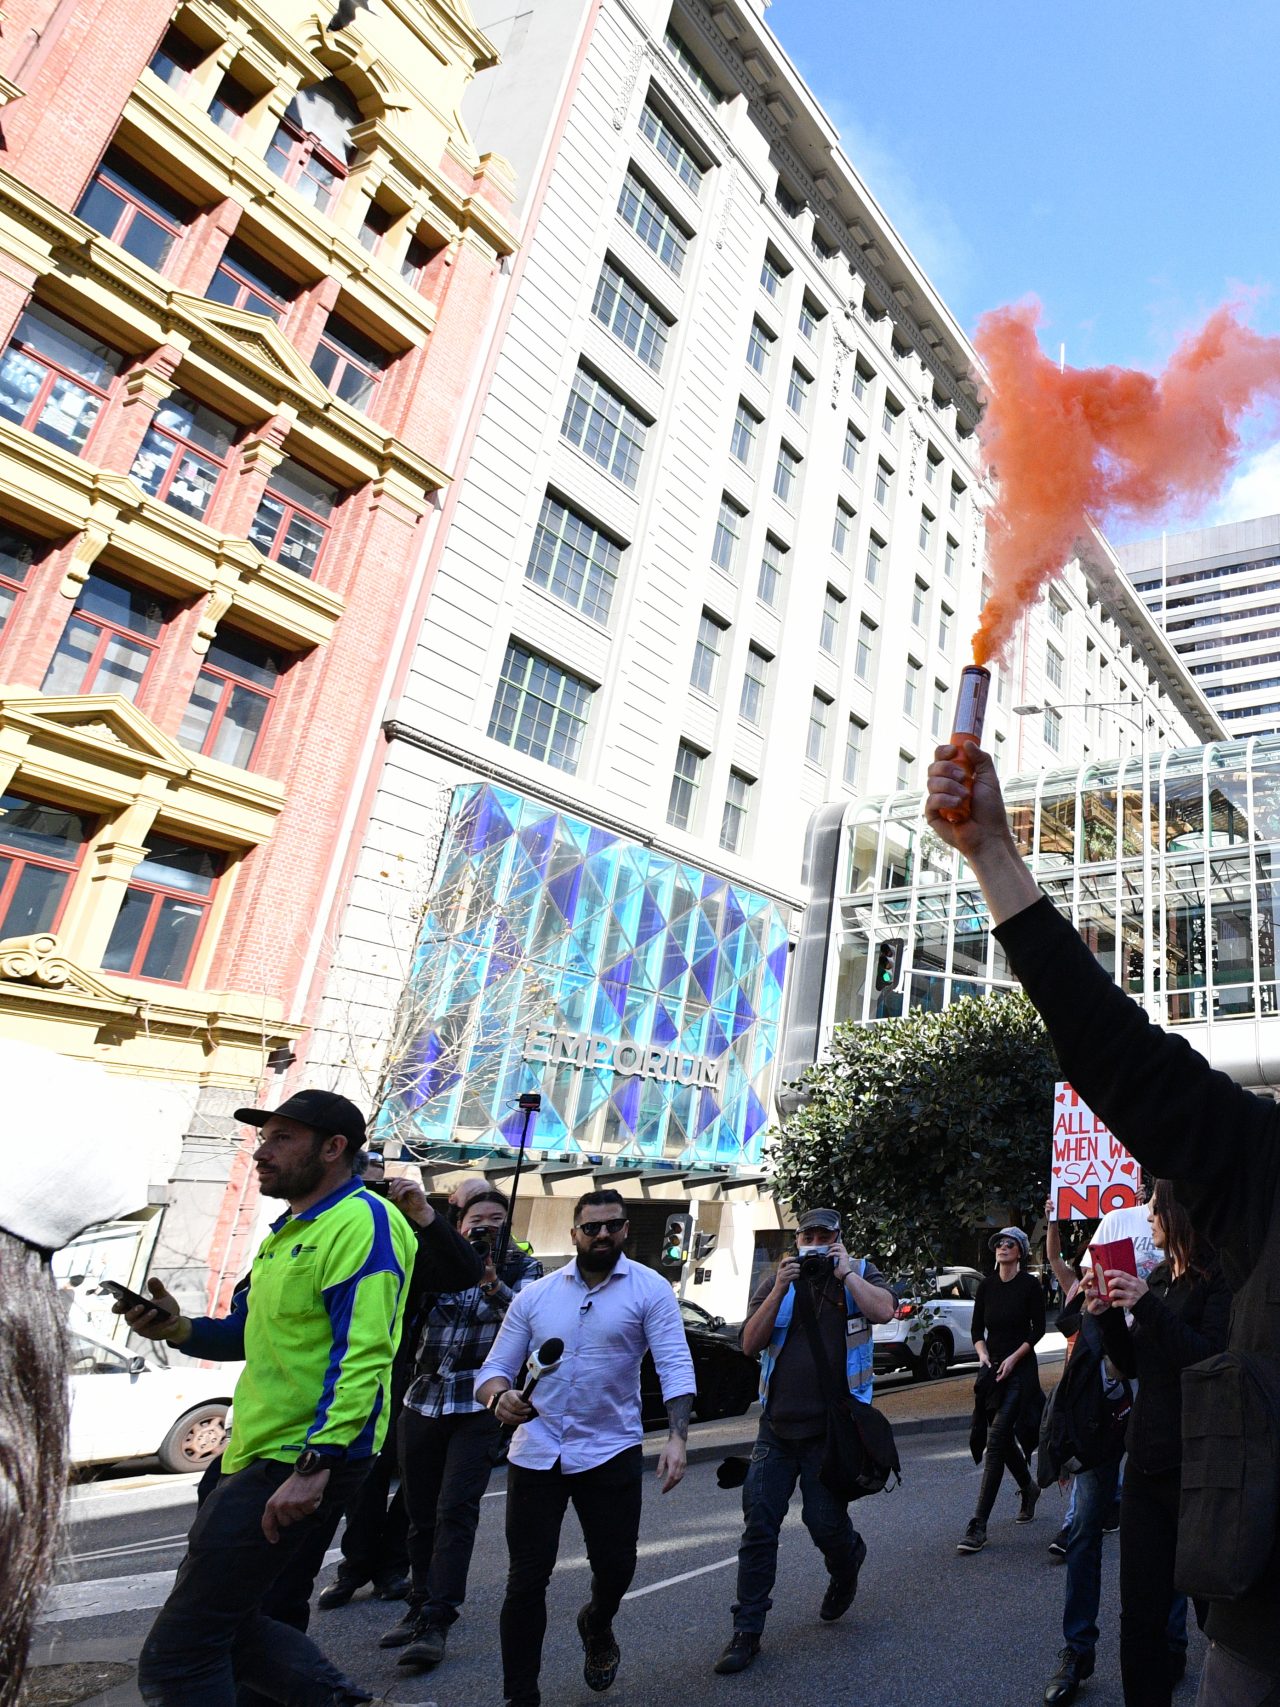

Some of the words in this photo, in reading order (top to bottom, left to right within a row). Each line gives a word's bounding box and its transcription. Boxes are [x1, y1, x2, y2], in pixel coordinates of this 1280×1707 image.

[523, 1021, 721, 1091] EMPORIUM
[1053, 1111, 1090, 1135] ALL
[1053, 1136, 1098, 1162] WHEN
[1064, 1159, 1118, 1185] SAY
[1057, 1183, 1136, 1221] NO
